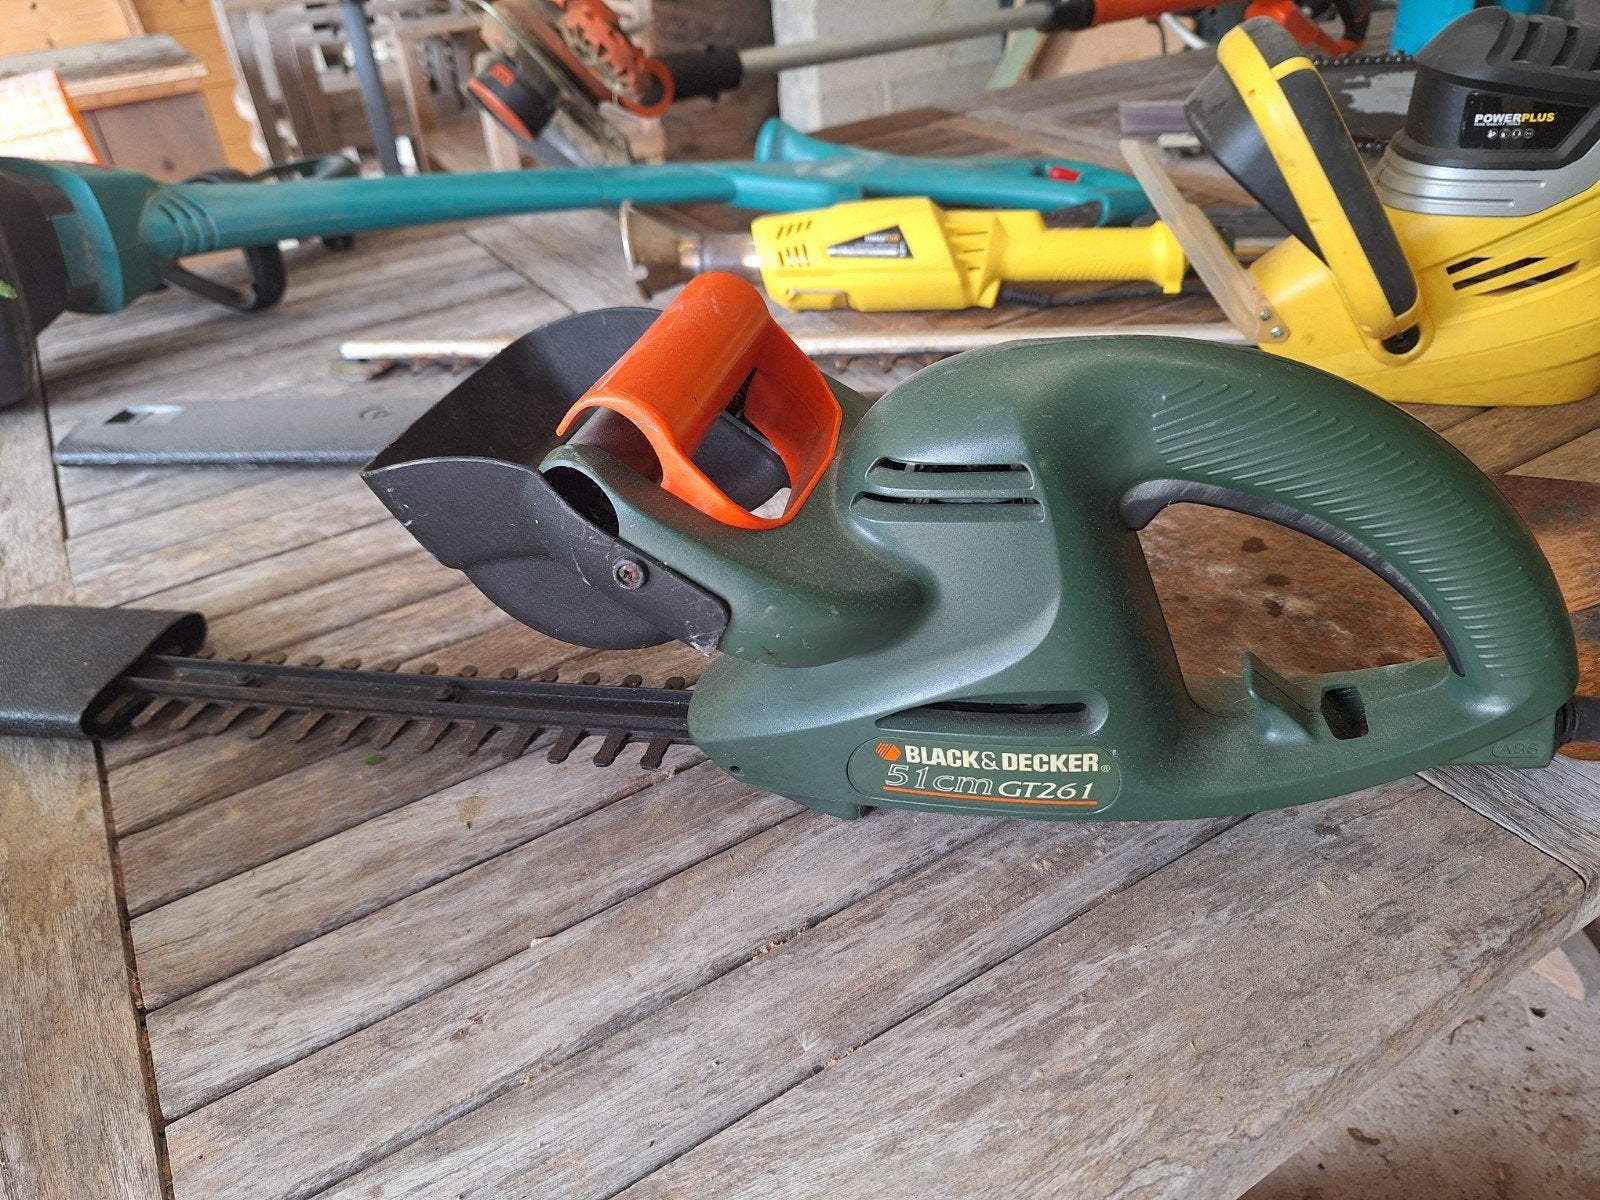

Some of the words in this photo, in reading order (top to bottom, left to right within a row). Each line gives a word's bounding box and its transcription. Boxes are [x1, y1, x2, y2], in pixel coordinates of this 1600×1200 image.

[1474, 112, 1556, 123] POWERPLUS
[884, 763, 994, 796] 51cm
[998, 780, 1094, 800] GT261
